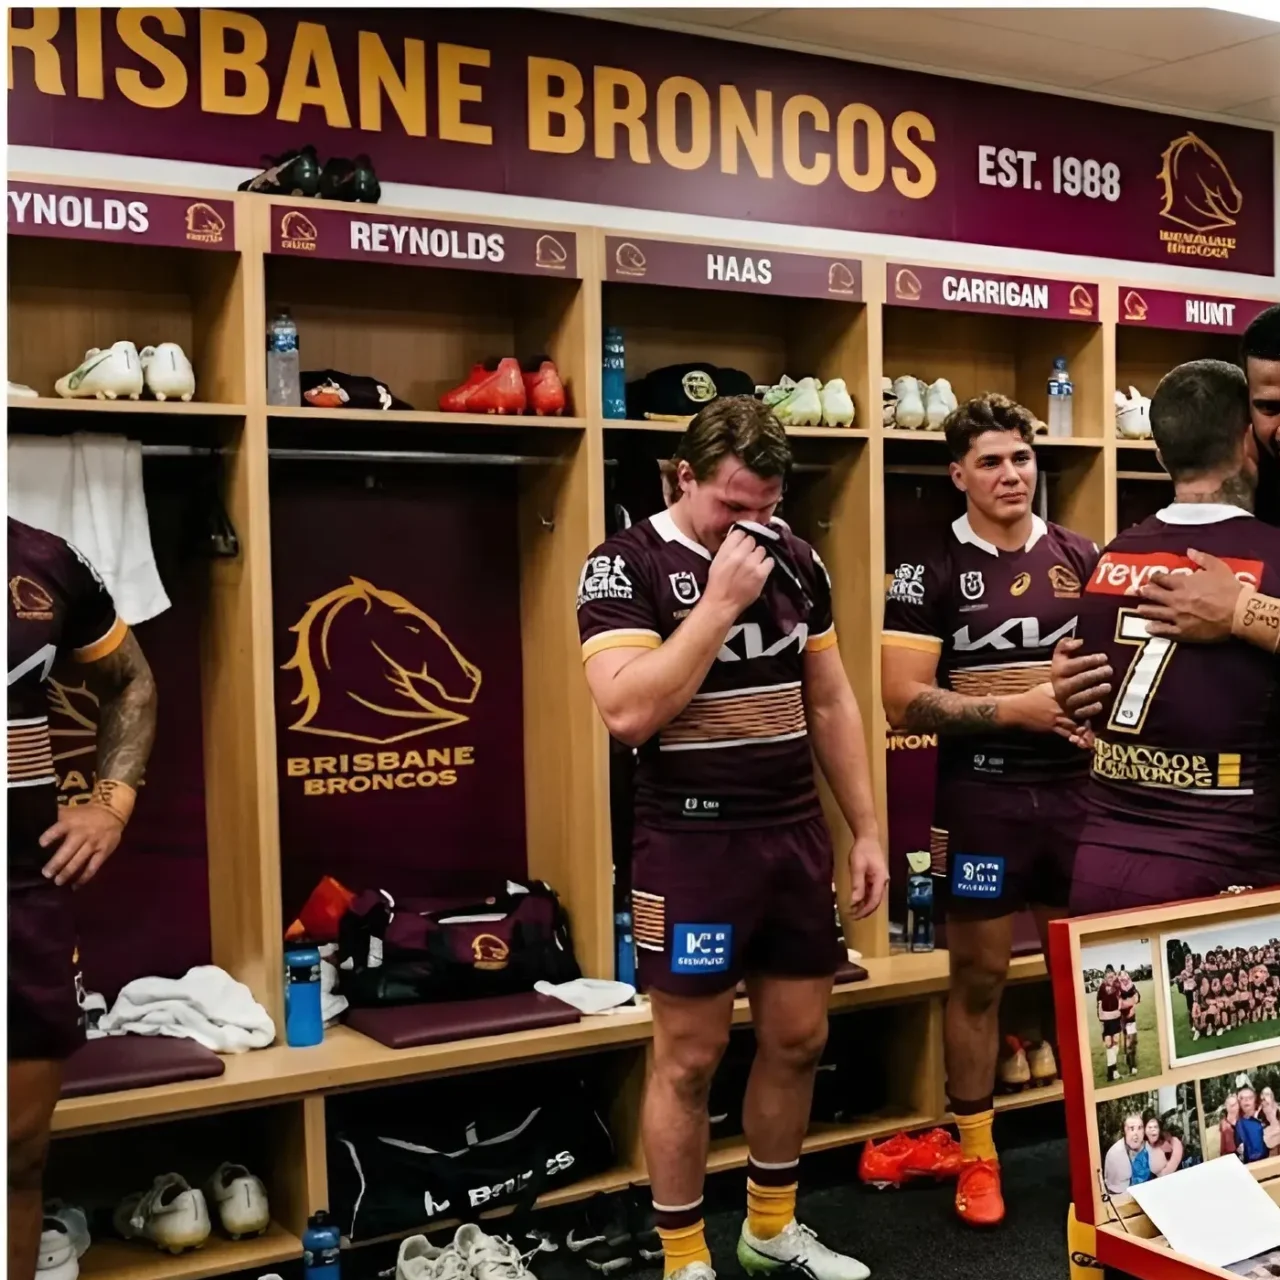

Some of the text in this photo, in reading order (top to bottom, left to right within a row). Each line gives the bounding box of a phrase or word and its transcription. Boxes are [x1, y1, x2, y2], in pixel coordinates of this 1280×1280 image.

[8, 8, 937, 199] RISBANE BRONCOS
[977, 145, 1121, 203] EST. 1988
[8, 191, 149, 233] YNOLDS
[350, 220, 505, 263] REYNOLDS
[706, 254, 773, 285] HAAS
[942, 276, 1049, 310] CARRIGAN
[1185, 299, 1236, 327] HUNT
[1107, 607, 1178, 735] 7
[287, 747, 475, 777] BRISBANE
[303, 769, 458, 796] BRONCOS
